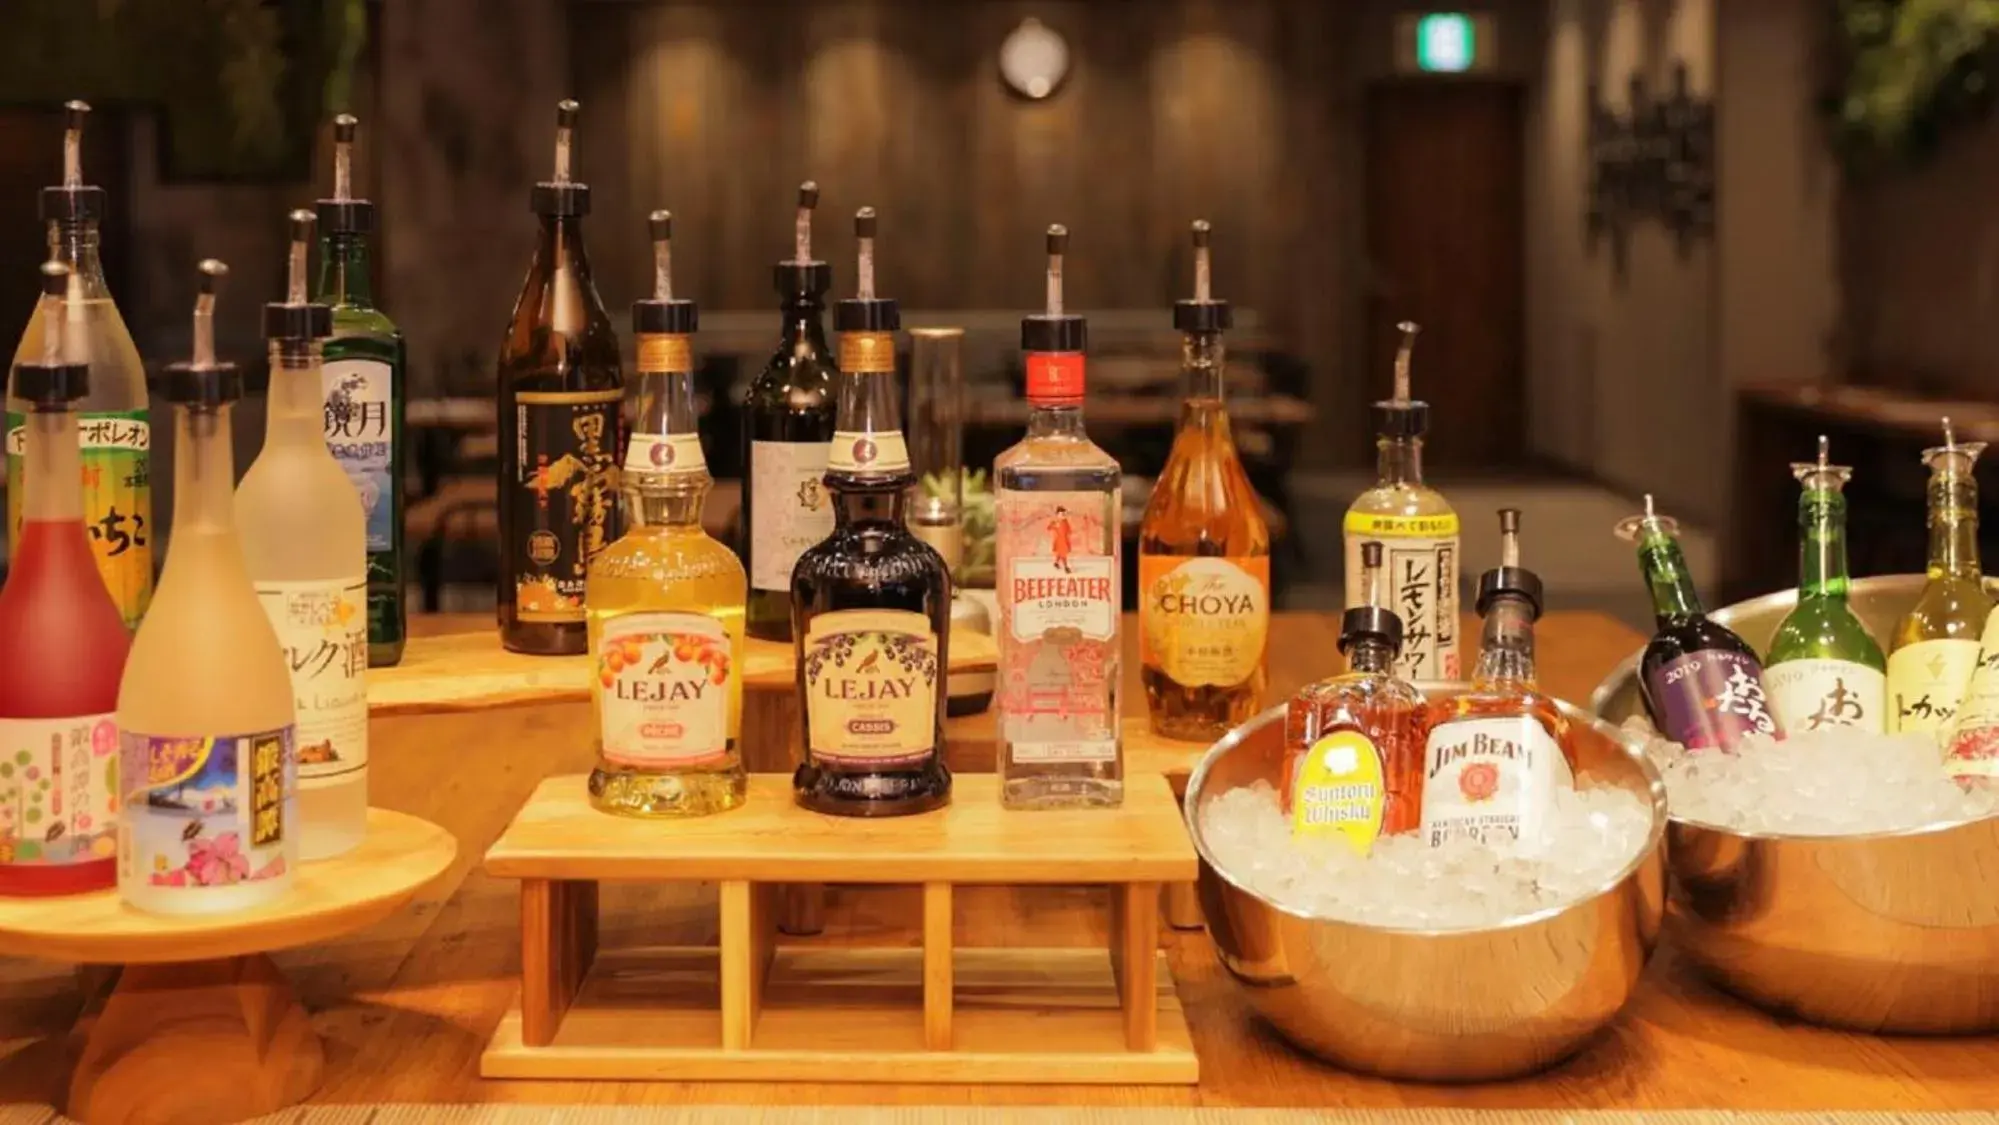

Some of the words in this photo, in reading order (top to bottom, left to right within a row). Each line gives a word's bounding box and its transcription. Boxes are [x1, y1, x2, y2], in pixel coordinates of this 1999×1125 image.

[1014, 577, 1112, 604] BEEFEATER
[1038, 600, 1088, 609] LONDON
[1160, 593, 1255, 615] CHOYA
[1400, 559, 1432, 680] レモンサワー
[616, 678, 708, 702] LEJAY
[824, 677, 916, 700] LEJAY
[1429, 741, 1468, 779] JIM
[1472, 733, 1533, 769] BEAM
